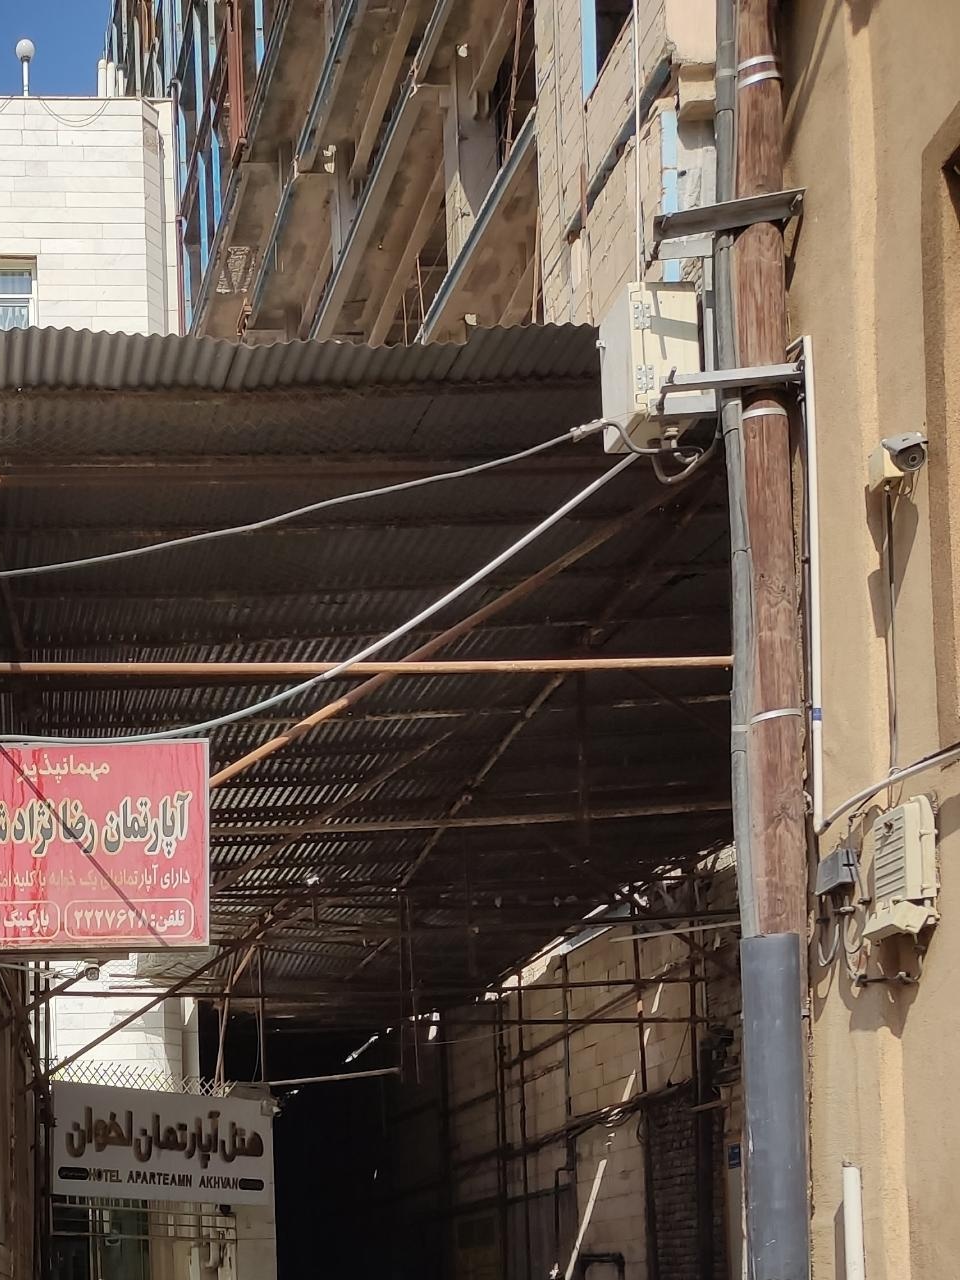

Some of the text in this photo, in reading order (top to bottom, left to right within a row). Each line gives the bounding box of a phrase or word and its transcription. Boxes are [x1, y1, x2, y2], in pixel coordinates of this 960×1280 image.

[16, 753, 110, 783] مهمانپذیر
[12, 797, 57, 858] نژاد
[59, 797, 97, 856] رضا
[104, 790, 193, 858] آپارتمان
[14, 869, 37, 891] کلیه
[160, 867, 191, 889] دارای
[3, 908, 49, 933] پارکینگ
[134, 1110, 221, 1169] آپارتمان
[220, 1121, 264, 1163] هتل
[88, 1167, 123, 1183] HOTEL
[127, 1170, 192, 1188] APARTEAMN
[199, 1175, 239, 1190] AKHVAN
